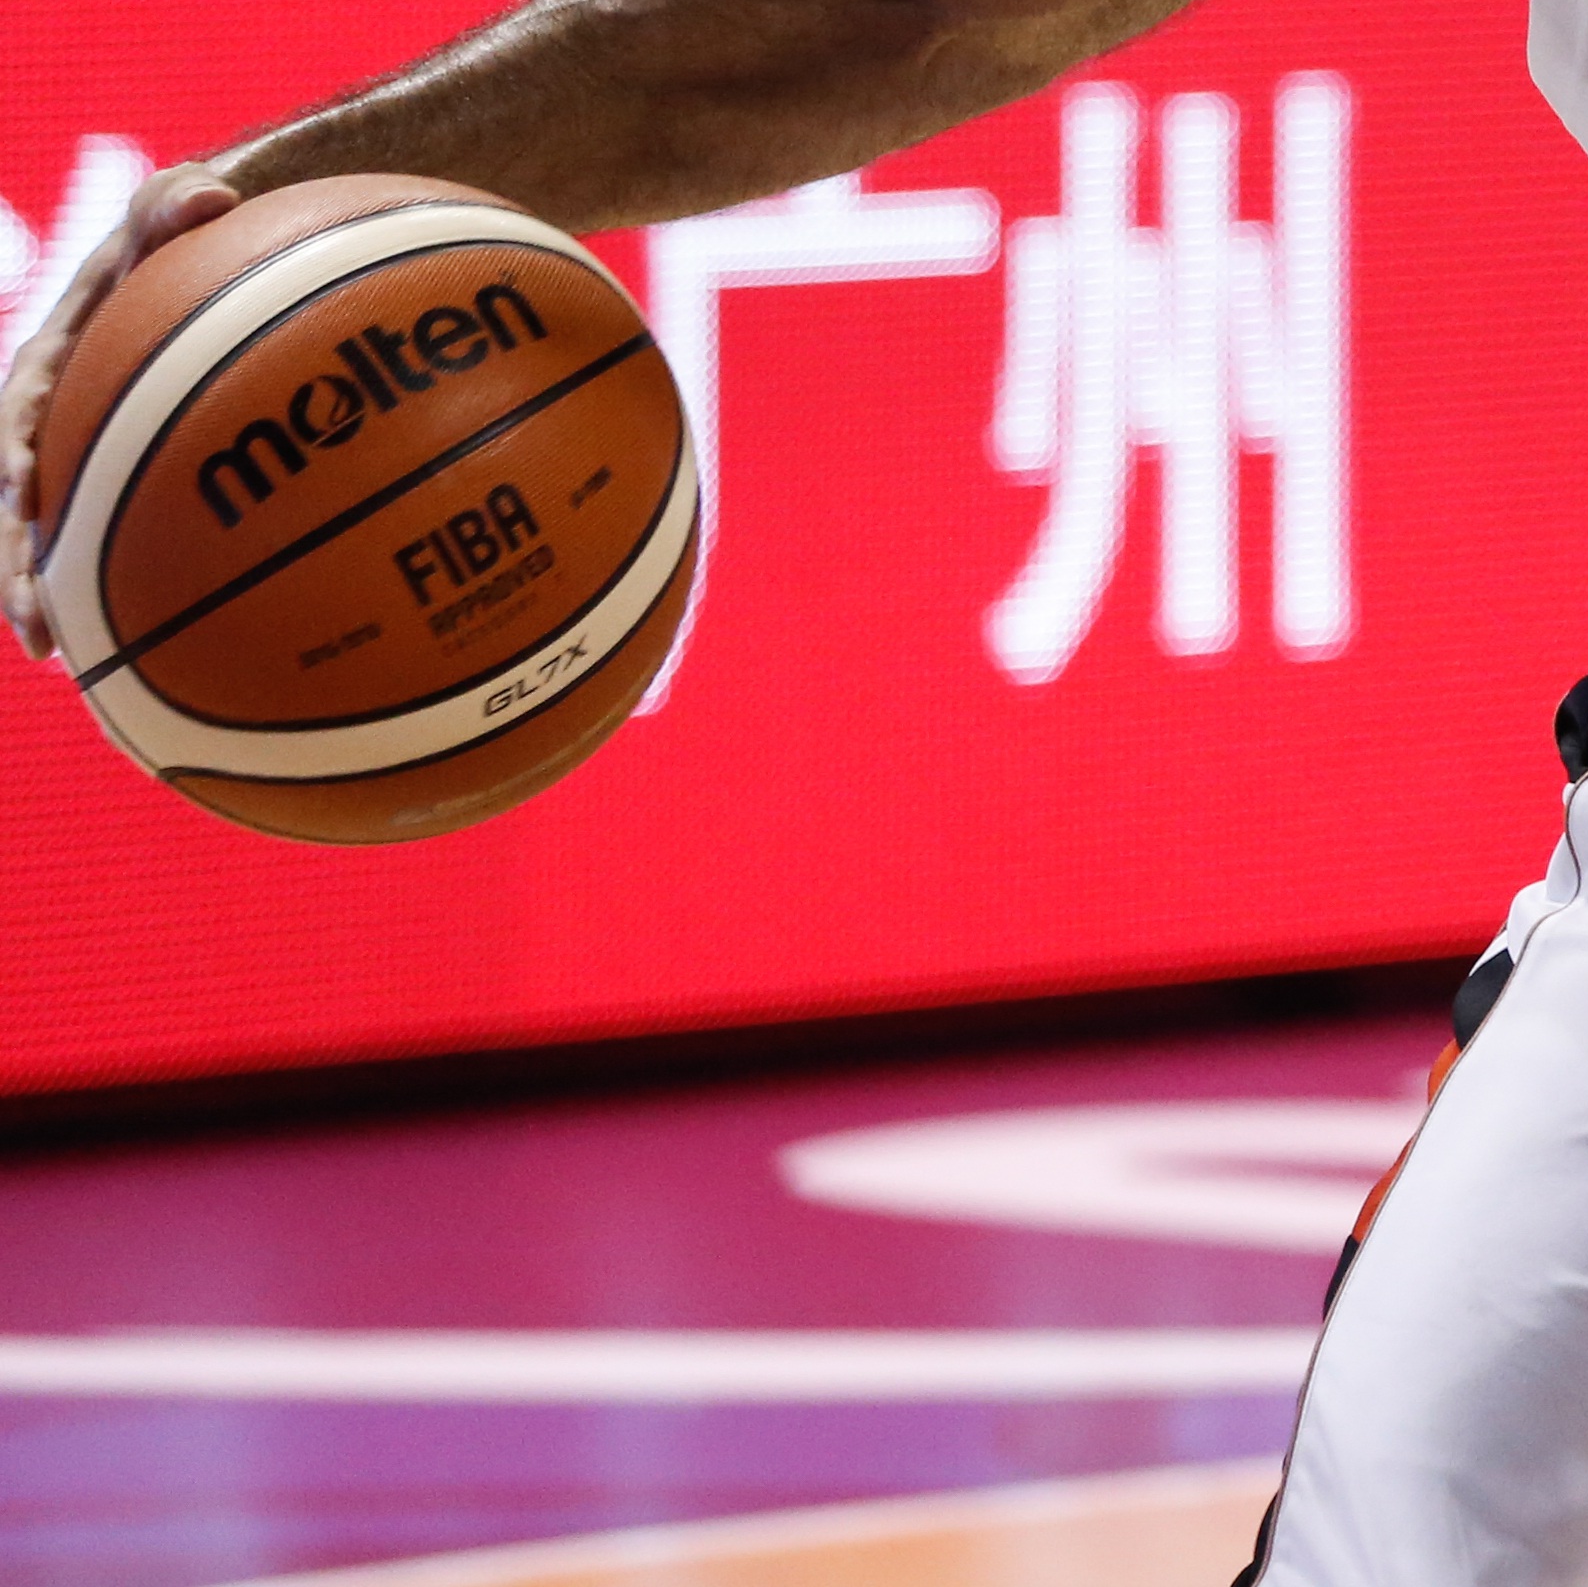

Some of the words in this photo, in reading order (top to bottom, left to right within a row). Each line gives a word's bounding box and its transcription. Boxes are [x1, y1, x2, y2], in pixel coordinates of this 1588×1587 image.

[197, 282, 548, 530] molten
[393, 482, 541, 607] FIBA
[482, 632, 589, 718] GL7X
